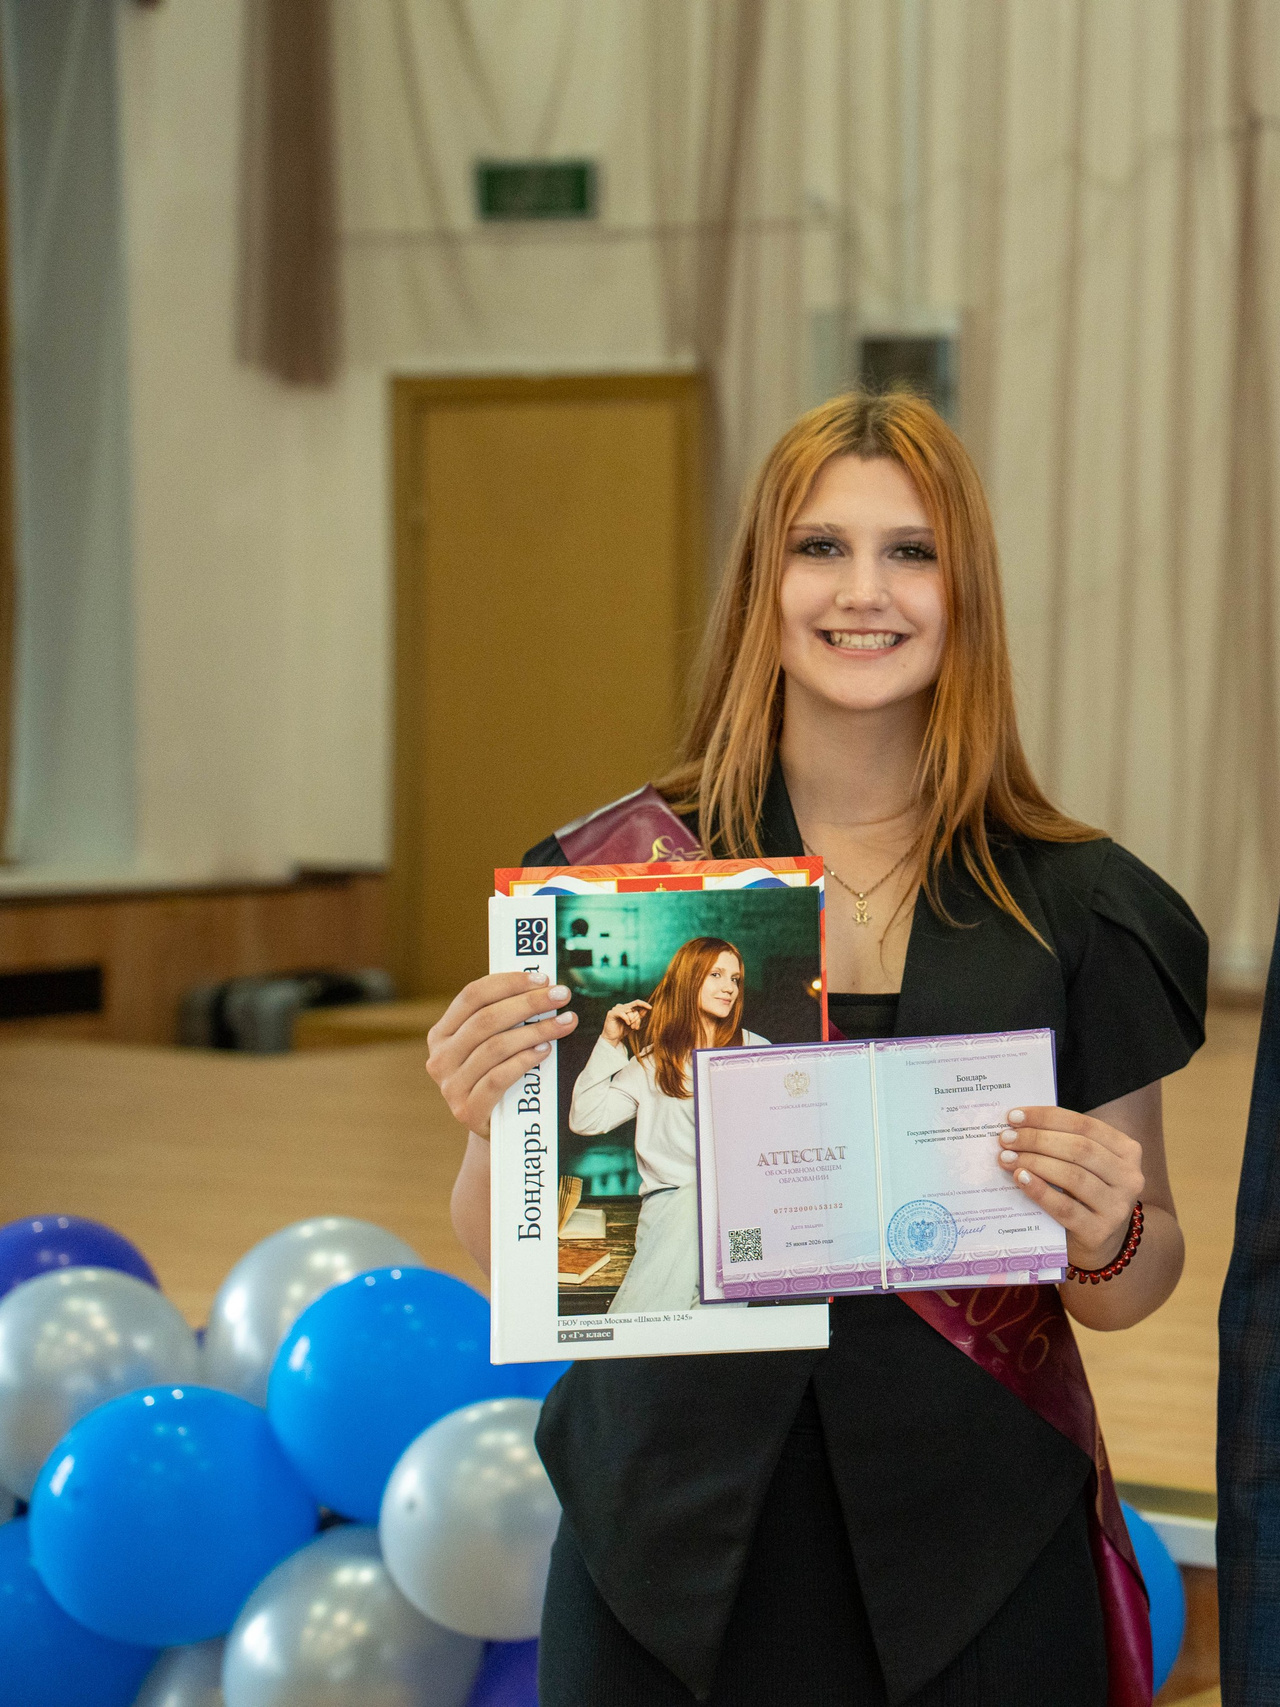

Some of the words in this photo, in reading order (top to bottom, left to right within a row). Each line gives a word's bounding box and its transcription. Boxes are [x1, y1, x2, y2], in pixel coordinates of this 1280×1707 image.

[517, 919, 547, 935] 20
[518, 934, 547, 953] 26
[956, 1073, 988, 1083] Бондарь
[934, 1086, 974, 1095] Валентина
[975, 1082, 1012, 1092] Петровна
[907, 1127, 951, 1137] Государственное
[951, 1125, 981, 1133] бюджетное
[914, 1136, 947, 1145] учреждение
[965, 1132, 987, 1140] Москвы
[757, 1145, 848, 1167] АТТЕСТАТ
[764, 1169, 775, 1177] ОБ
[775, 1166, 815, 1176] ОСНОВНОМ
[815, 1164, 842, 1173] ОБЩЕМ
[518, 1123, 547, 1241] Бондарь
[778, 1174, 830, 1184] ОБРАЗОВАНИИ
[557, 1318, 578, 1327] ГБОУ
[579, 1319, 603, 1327] города
[604, 1317, 633, 1325] Москвы
[633, 1315, 662, 1324] «Школа
[663, 1314, 671, 1322] №
[673, 1313, 693, 1322] 1245»
[560, 1333, 567, 1341] 9
[568, 1331, 584, 1339] «Г»
[585, 1330, 611, 1339] класс
